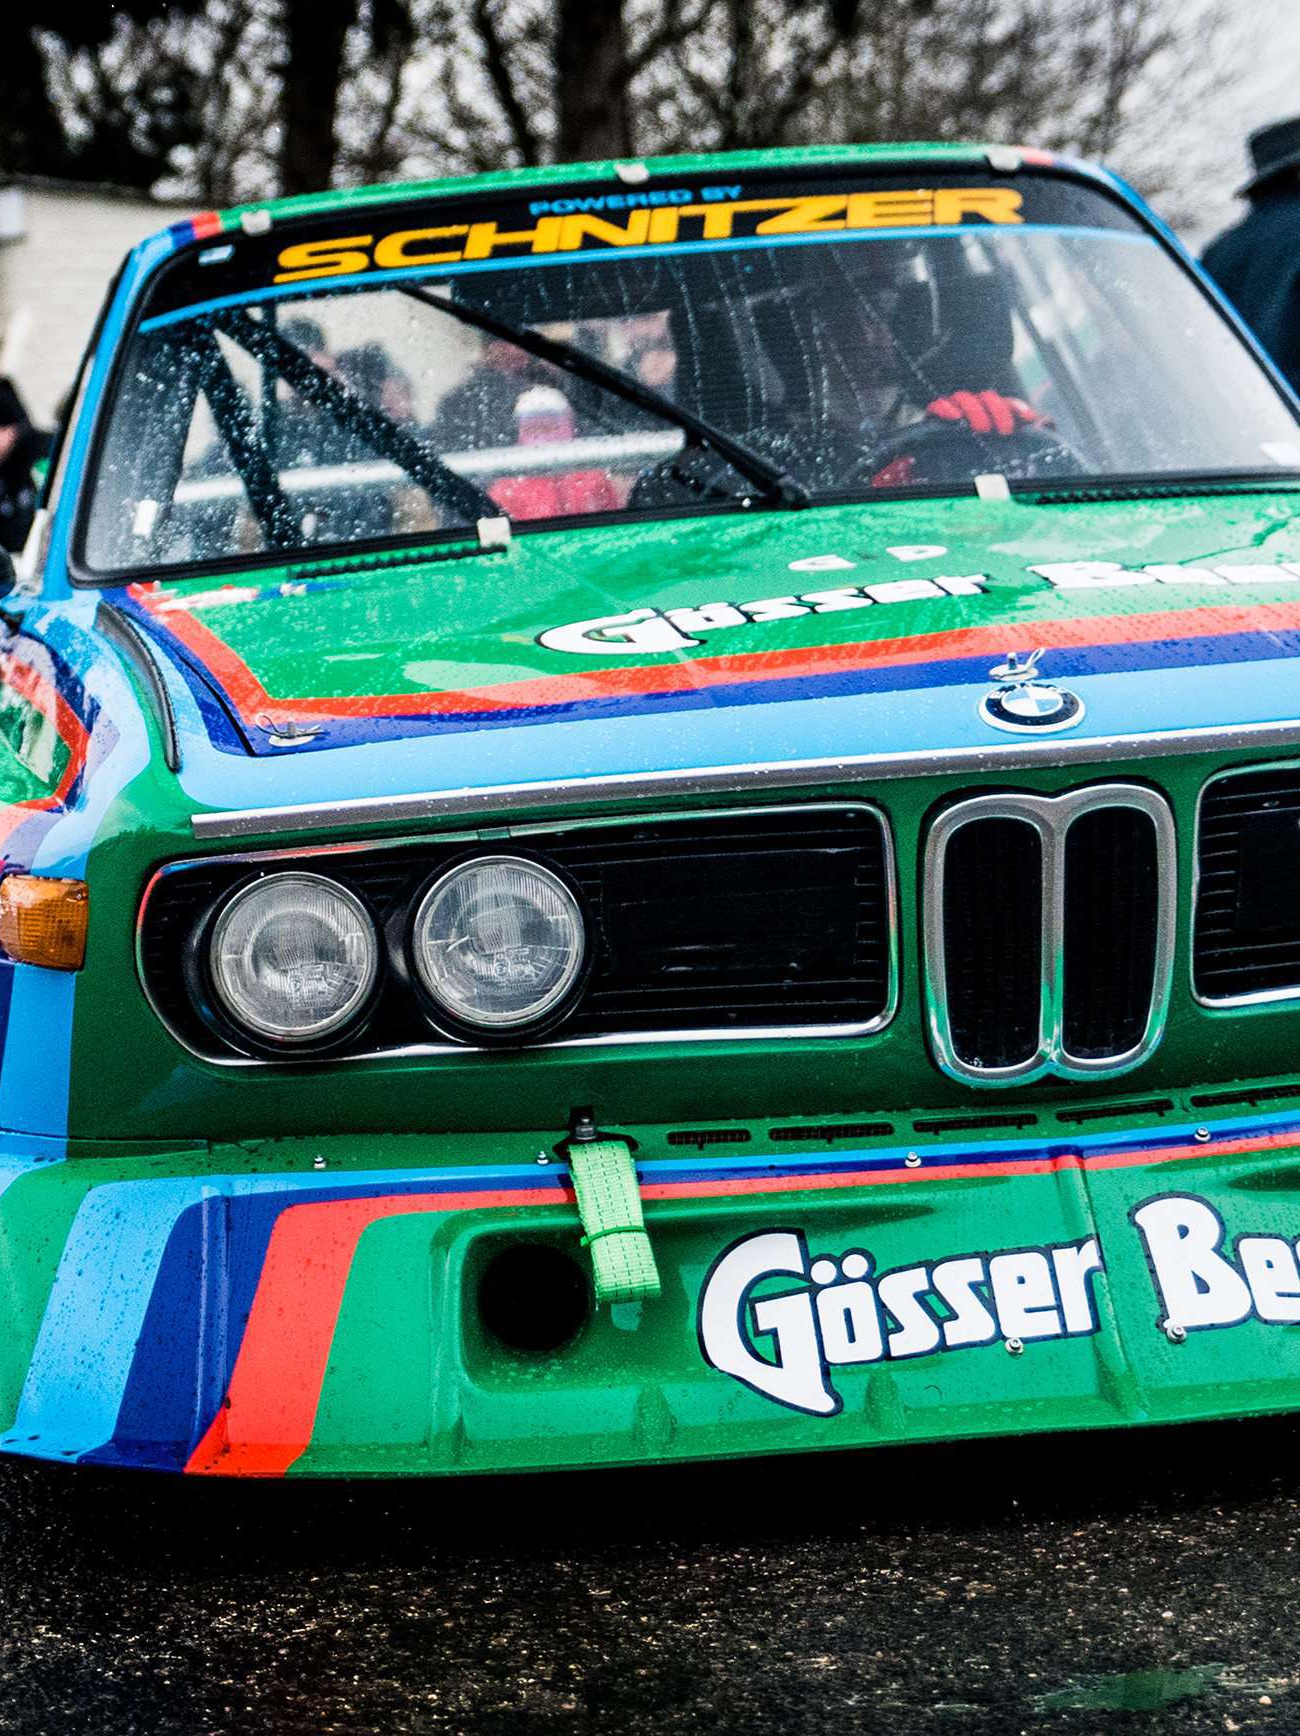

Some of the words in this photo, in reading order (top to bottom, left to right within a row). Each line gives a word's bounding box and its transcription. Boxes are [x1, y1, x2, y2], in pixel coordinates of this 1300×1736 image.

[274, 187, 1025, 282] SCHNITZER
[528, 189, 693, 216] POWERED
[701, 184, 742, 200] BY
[534, 573, 992, 655] Gösser
[1023, 560, 1300, 589] Bee
[699, 1227, 1103, 1417] Gösser
[1127, 1190, 1300, 1334] Be
